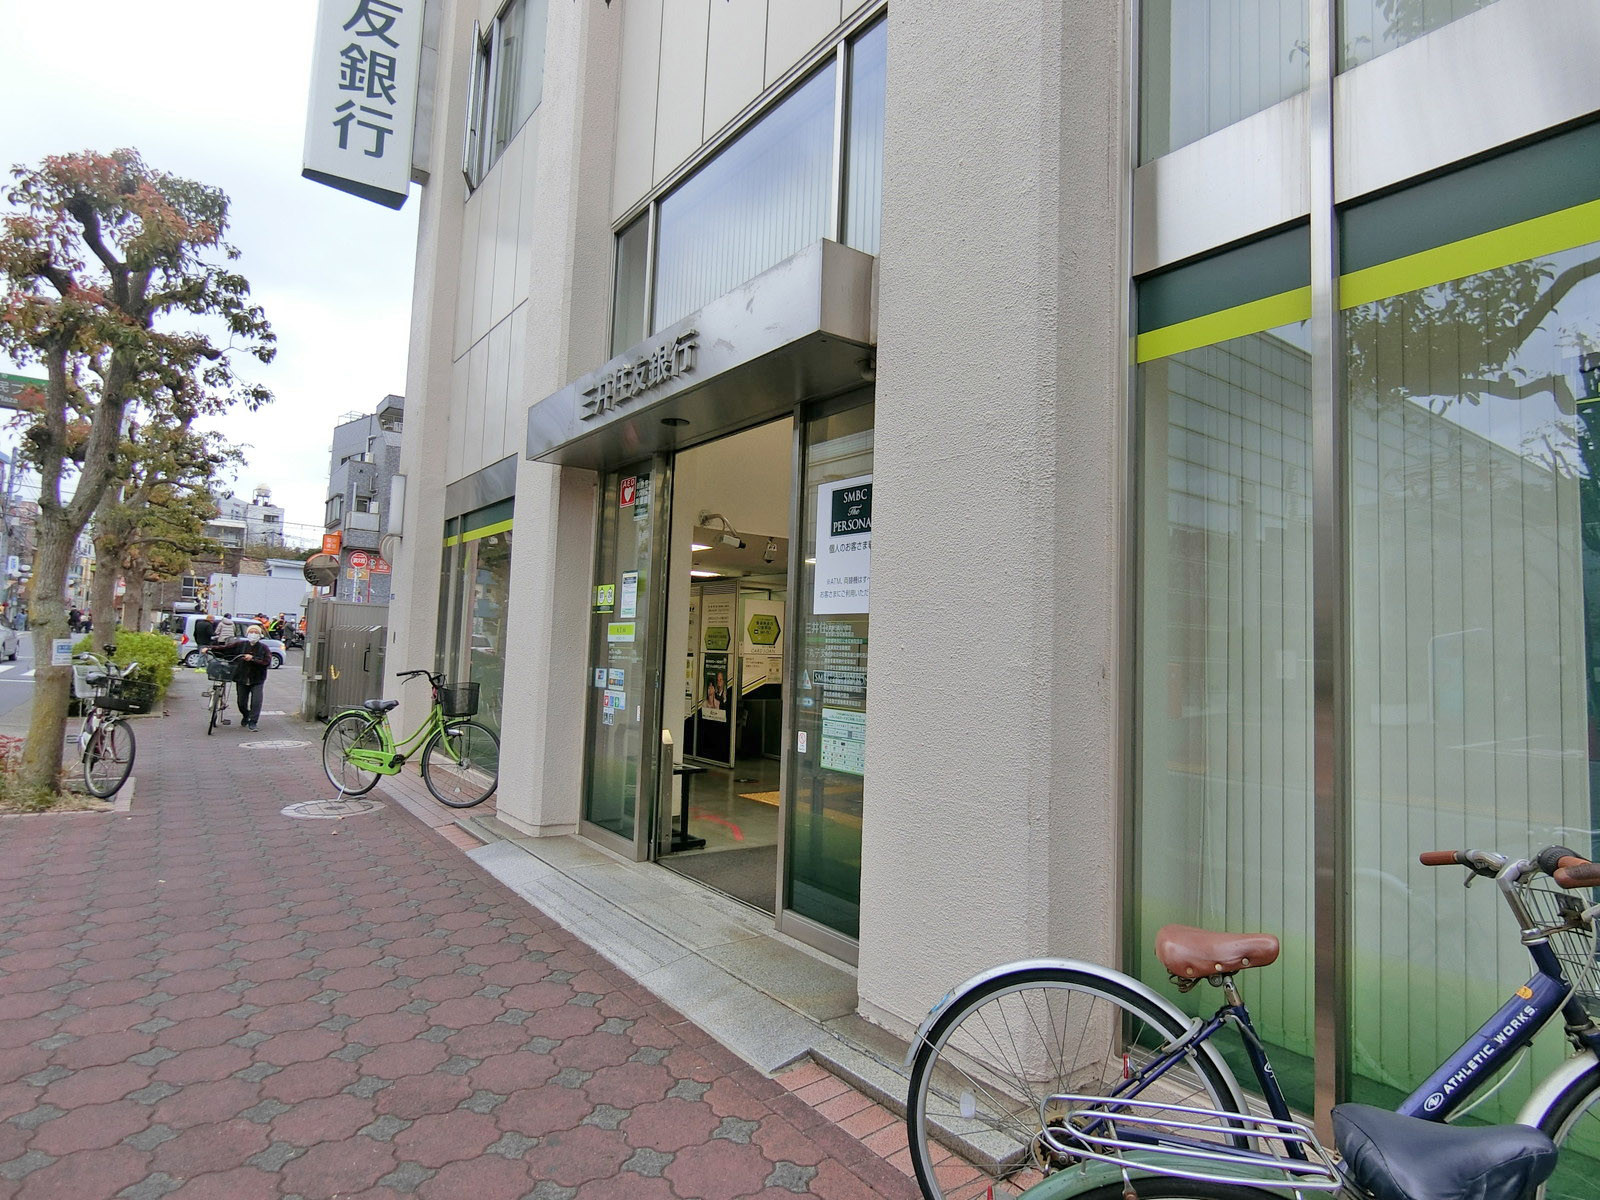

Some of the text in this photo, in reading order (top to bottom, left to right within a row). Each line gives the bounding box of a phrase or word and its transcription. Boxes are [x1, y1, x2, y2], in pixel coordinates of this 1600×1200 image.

[579, 328, 700, 421] 三井住友銀行
[622, 478, 635, 488] AED
[843, 488, 868, 504] SMBC
[847, 504, 863, 516] The
[1443, 1005, 1536, 1095] ATHLETIC WORKS
